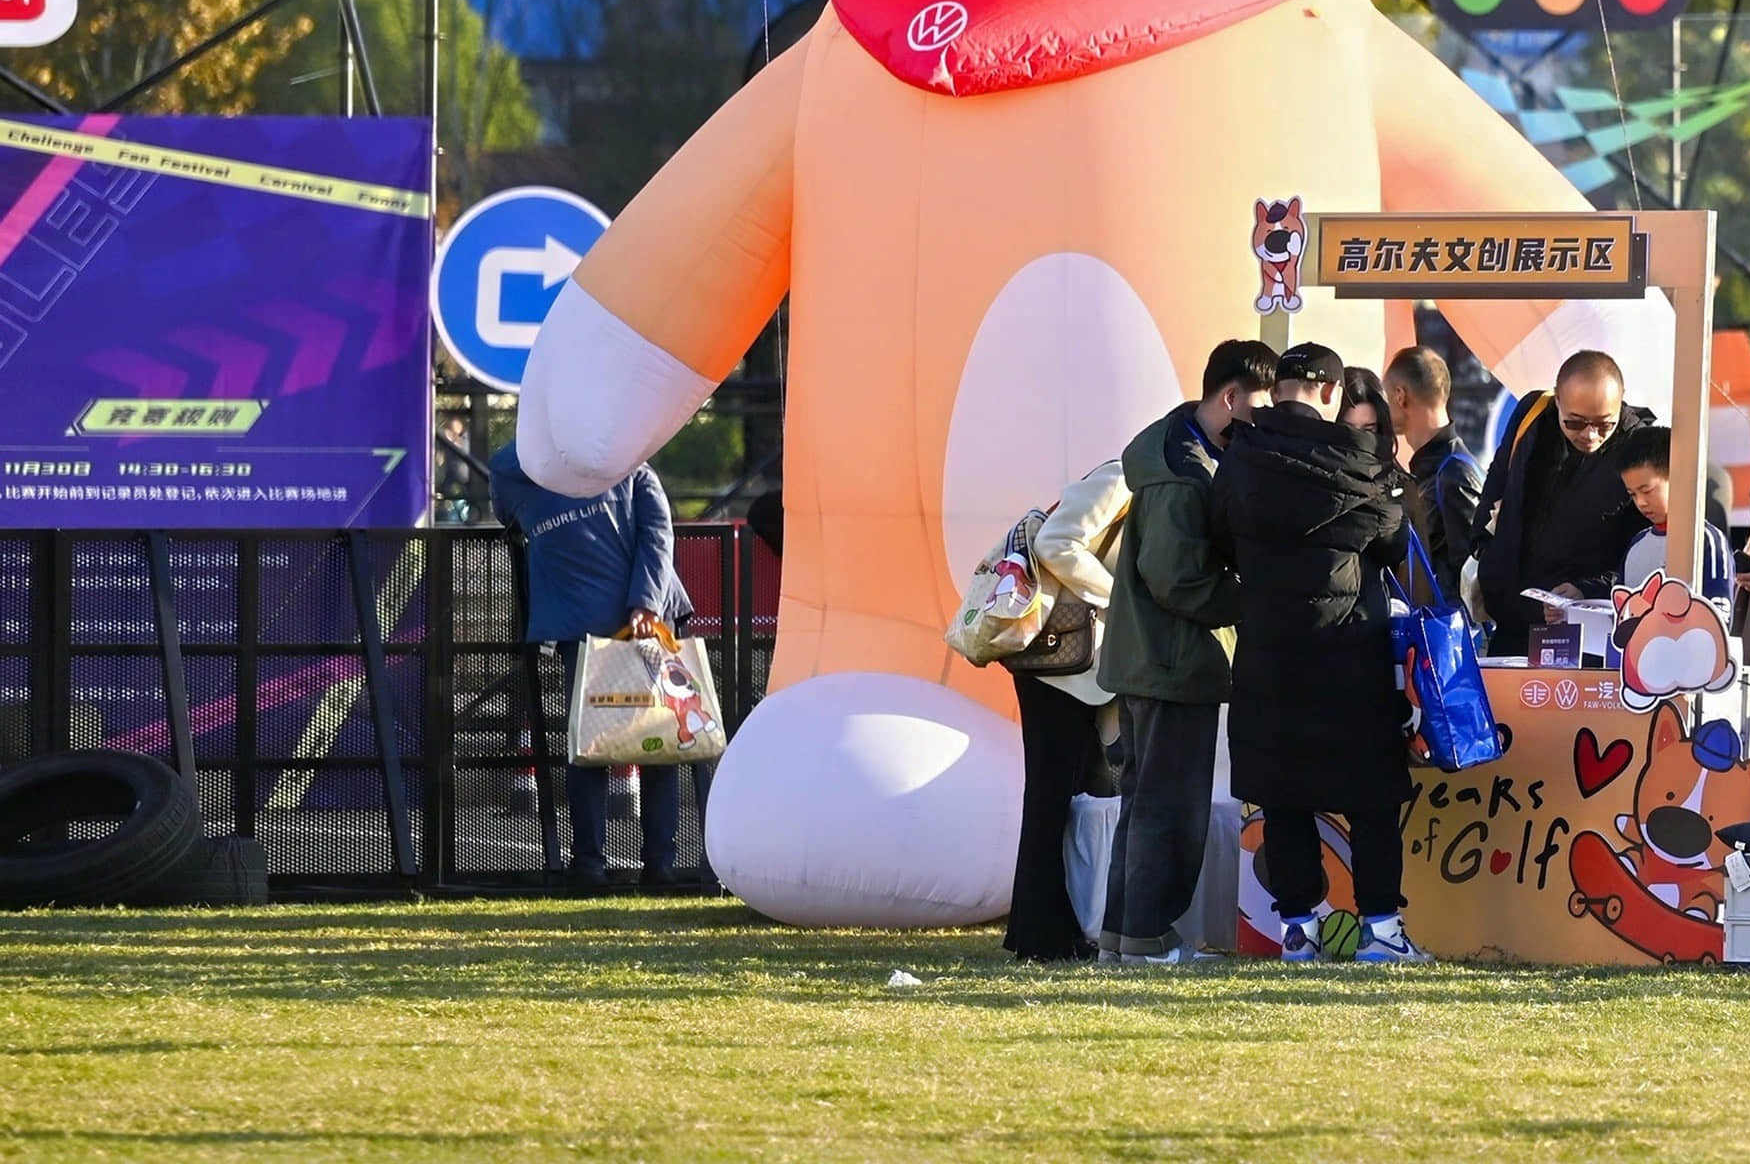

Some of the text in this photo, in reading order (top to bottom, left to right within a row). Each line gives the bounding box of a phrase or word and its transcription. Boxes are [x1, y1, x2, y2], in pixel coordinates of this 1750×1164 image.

[7, 128, 94, 154] Challenge
[118, 148, 150, 164] Fan
[160, 157, 231, 179] Festival
[1337, 237, 1615, 272] 高尔夫文创展示区
[5, 461, 91, 476] 11月30日
[532, 510, 578, 537] LEISURE
[1411, 817, 1440, 862] of
